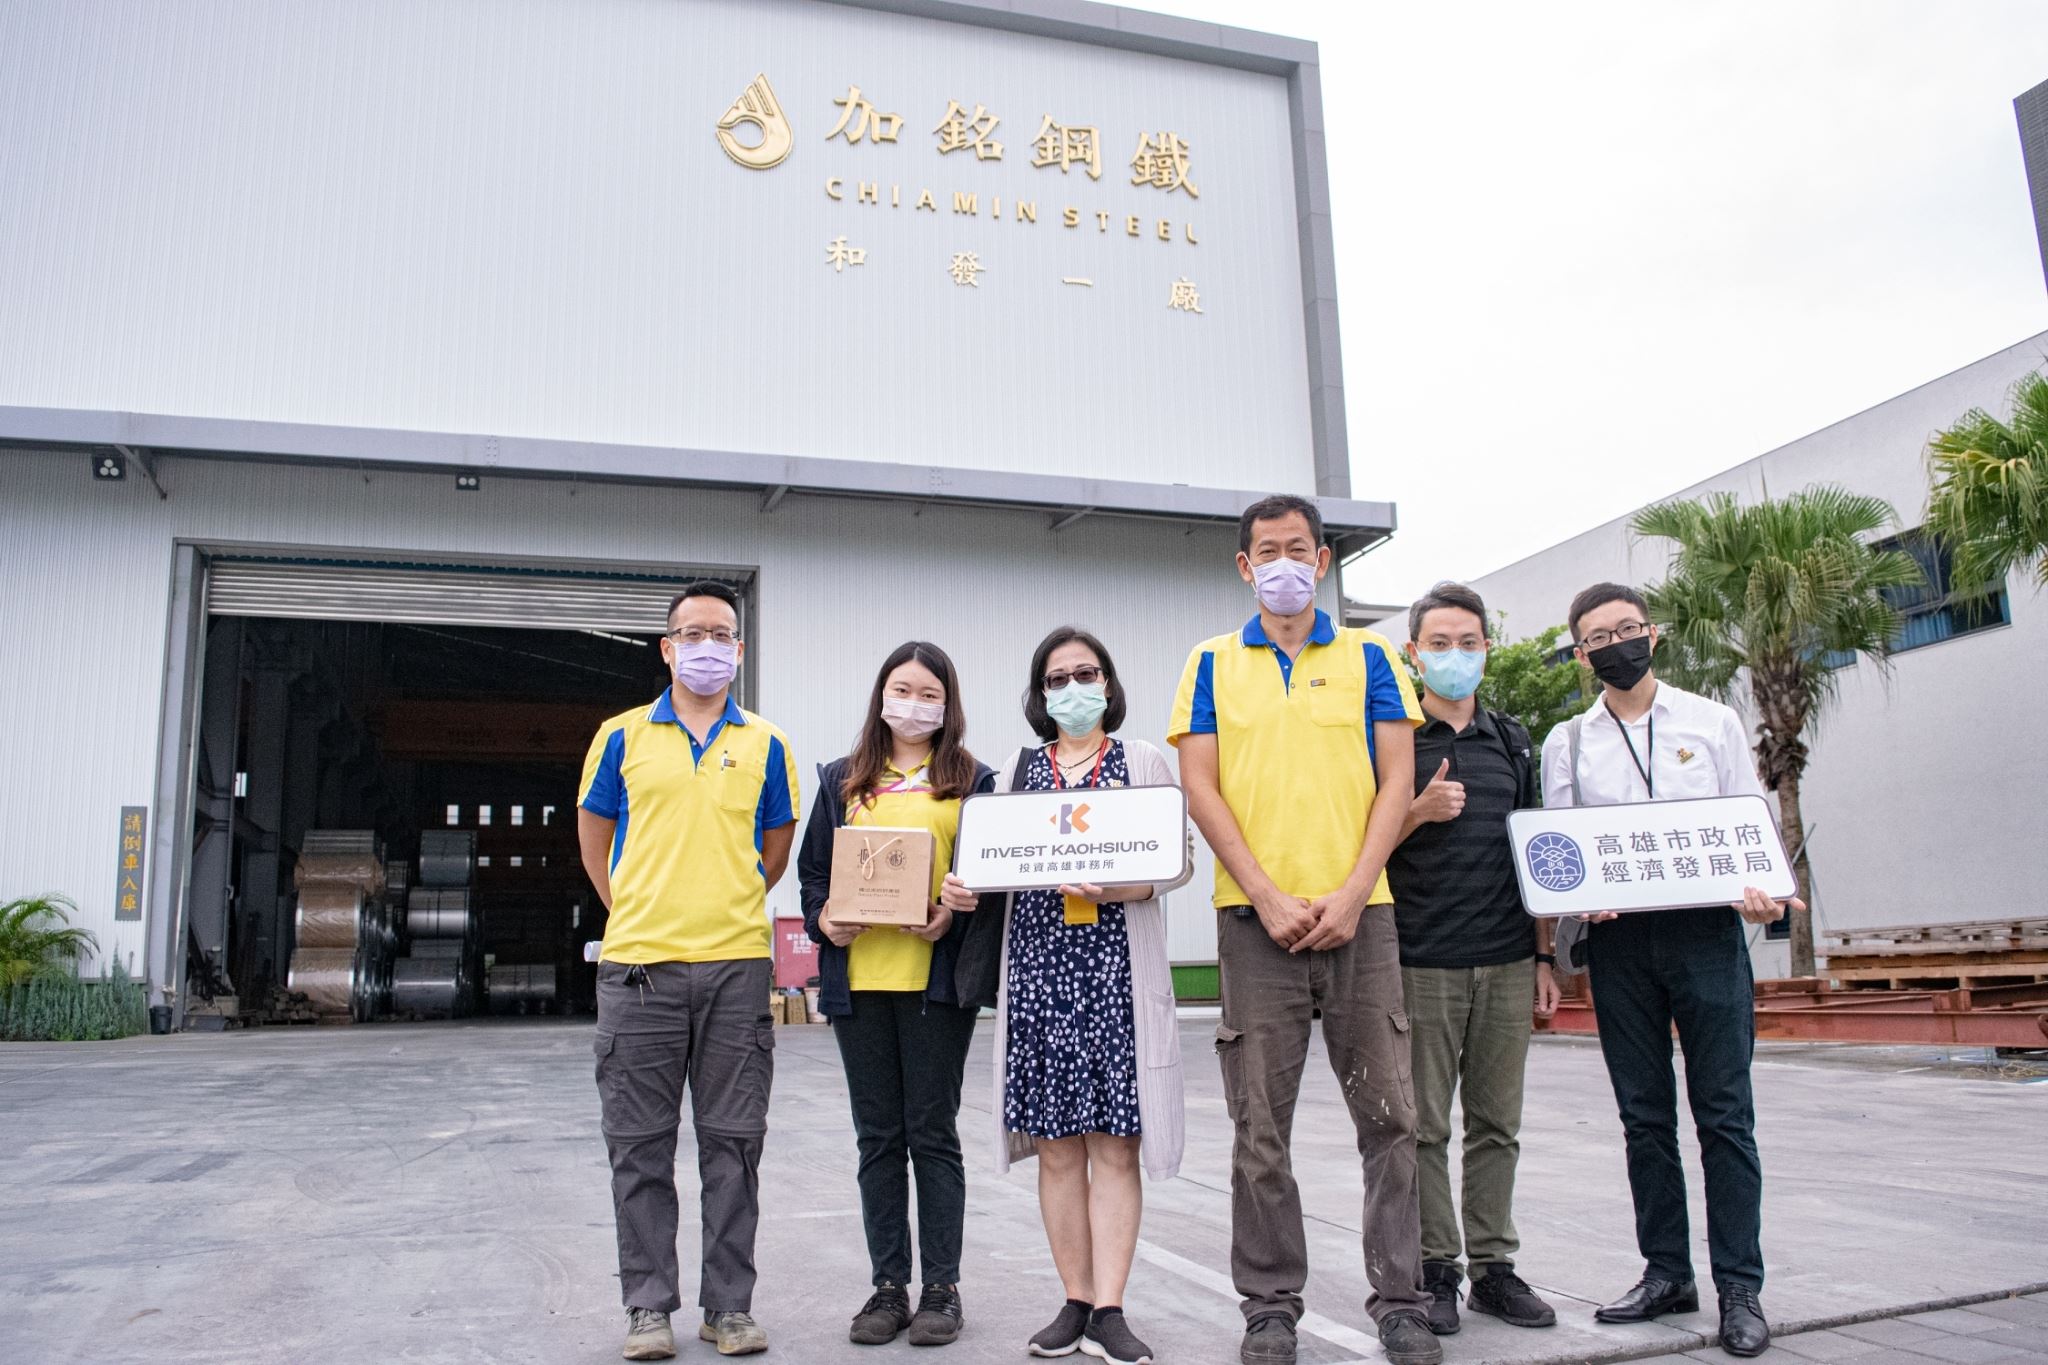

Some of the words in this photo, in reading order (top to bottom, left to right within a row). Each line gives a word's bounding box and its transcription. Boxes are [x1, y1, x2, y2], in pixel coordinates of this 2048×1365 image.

[825, 84, 1199, 198] 加銘鋼鐵
[825, 177, 1037, 224] CHIAMIN
[1063, 206, 1199, 245] STEEL
[826, 235, 1204, 314] 和發一廠
[1593, 823, 1763, 857] 高雄市政府
[1018, 859, 1115, 873] 投資高雄事務所
[1601, 851, 1773, 884] 經濟發展局
